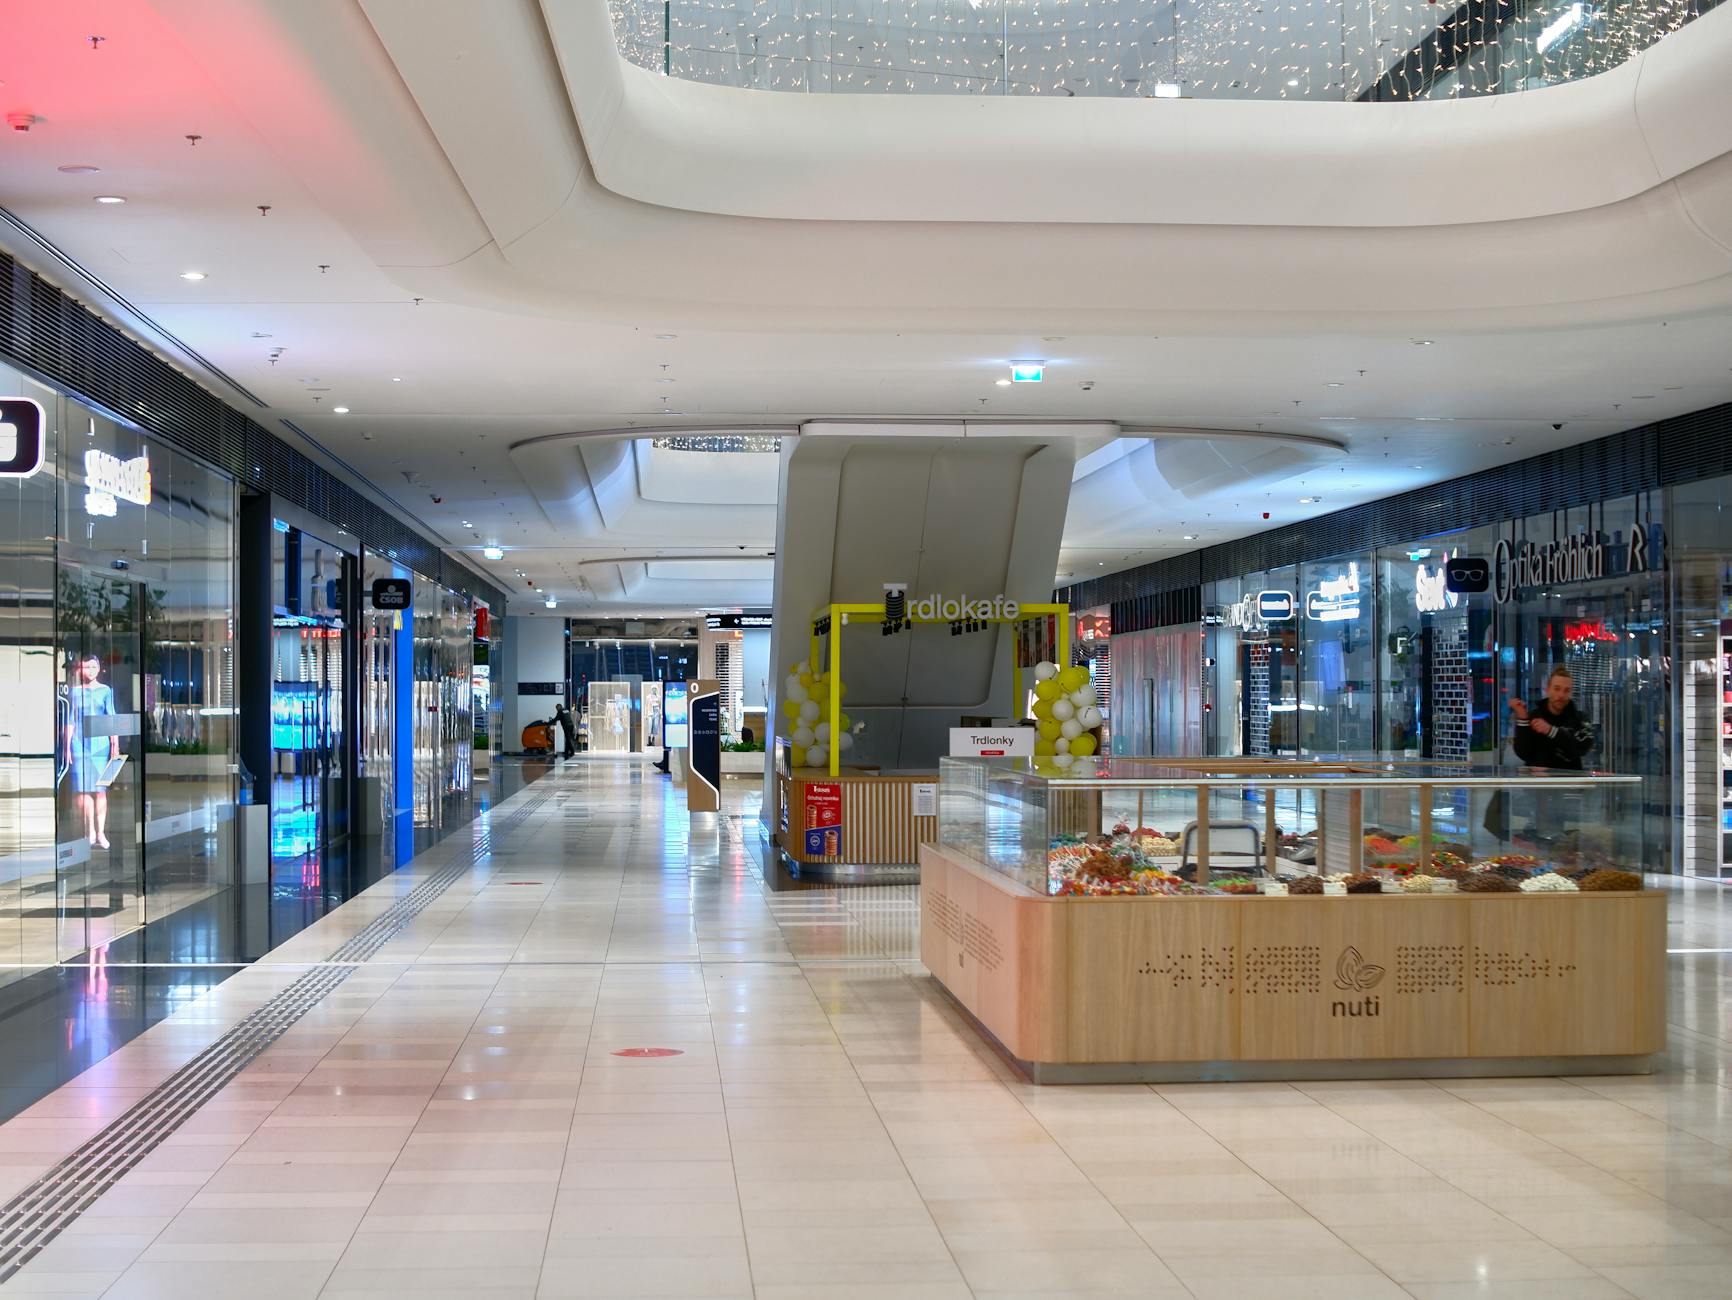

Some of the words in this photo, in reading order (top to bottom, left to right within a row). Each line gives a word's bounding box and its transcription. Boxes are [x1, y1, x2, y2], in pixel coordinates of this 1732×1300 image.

[1493, 539, 1543, 604] Optika
[1545, 531, 1603, 585] Fröhlich
[970, 735, 1015, 747] Trdlonky
[1332, 995, 1380, 1017] nuti
